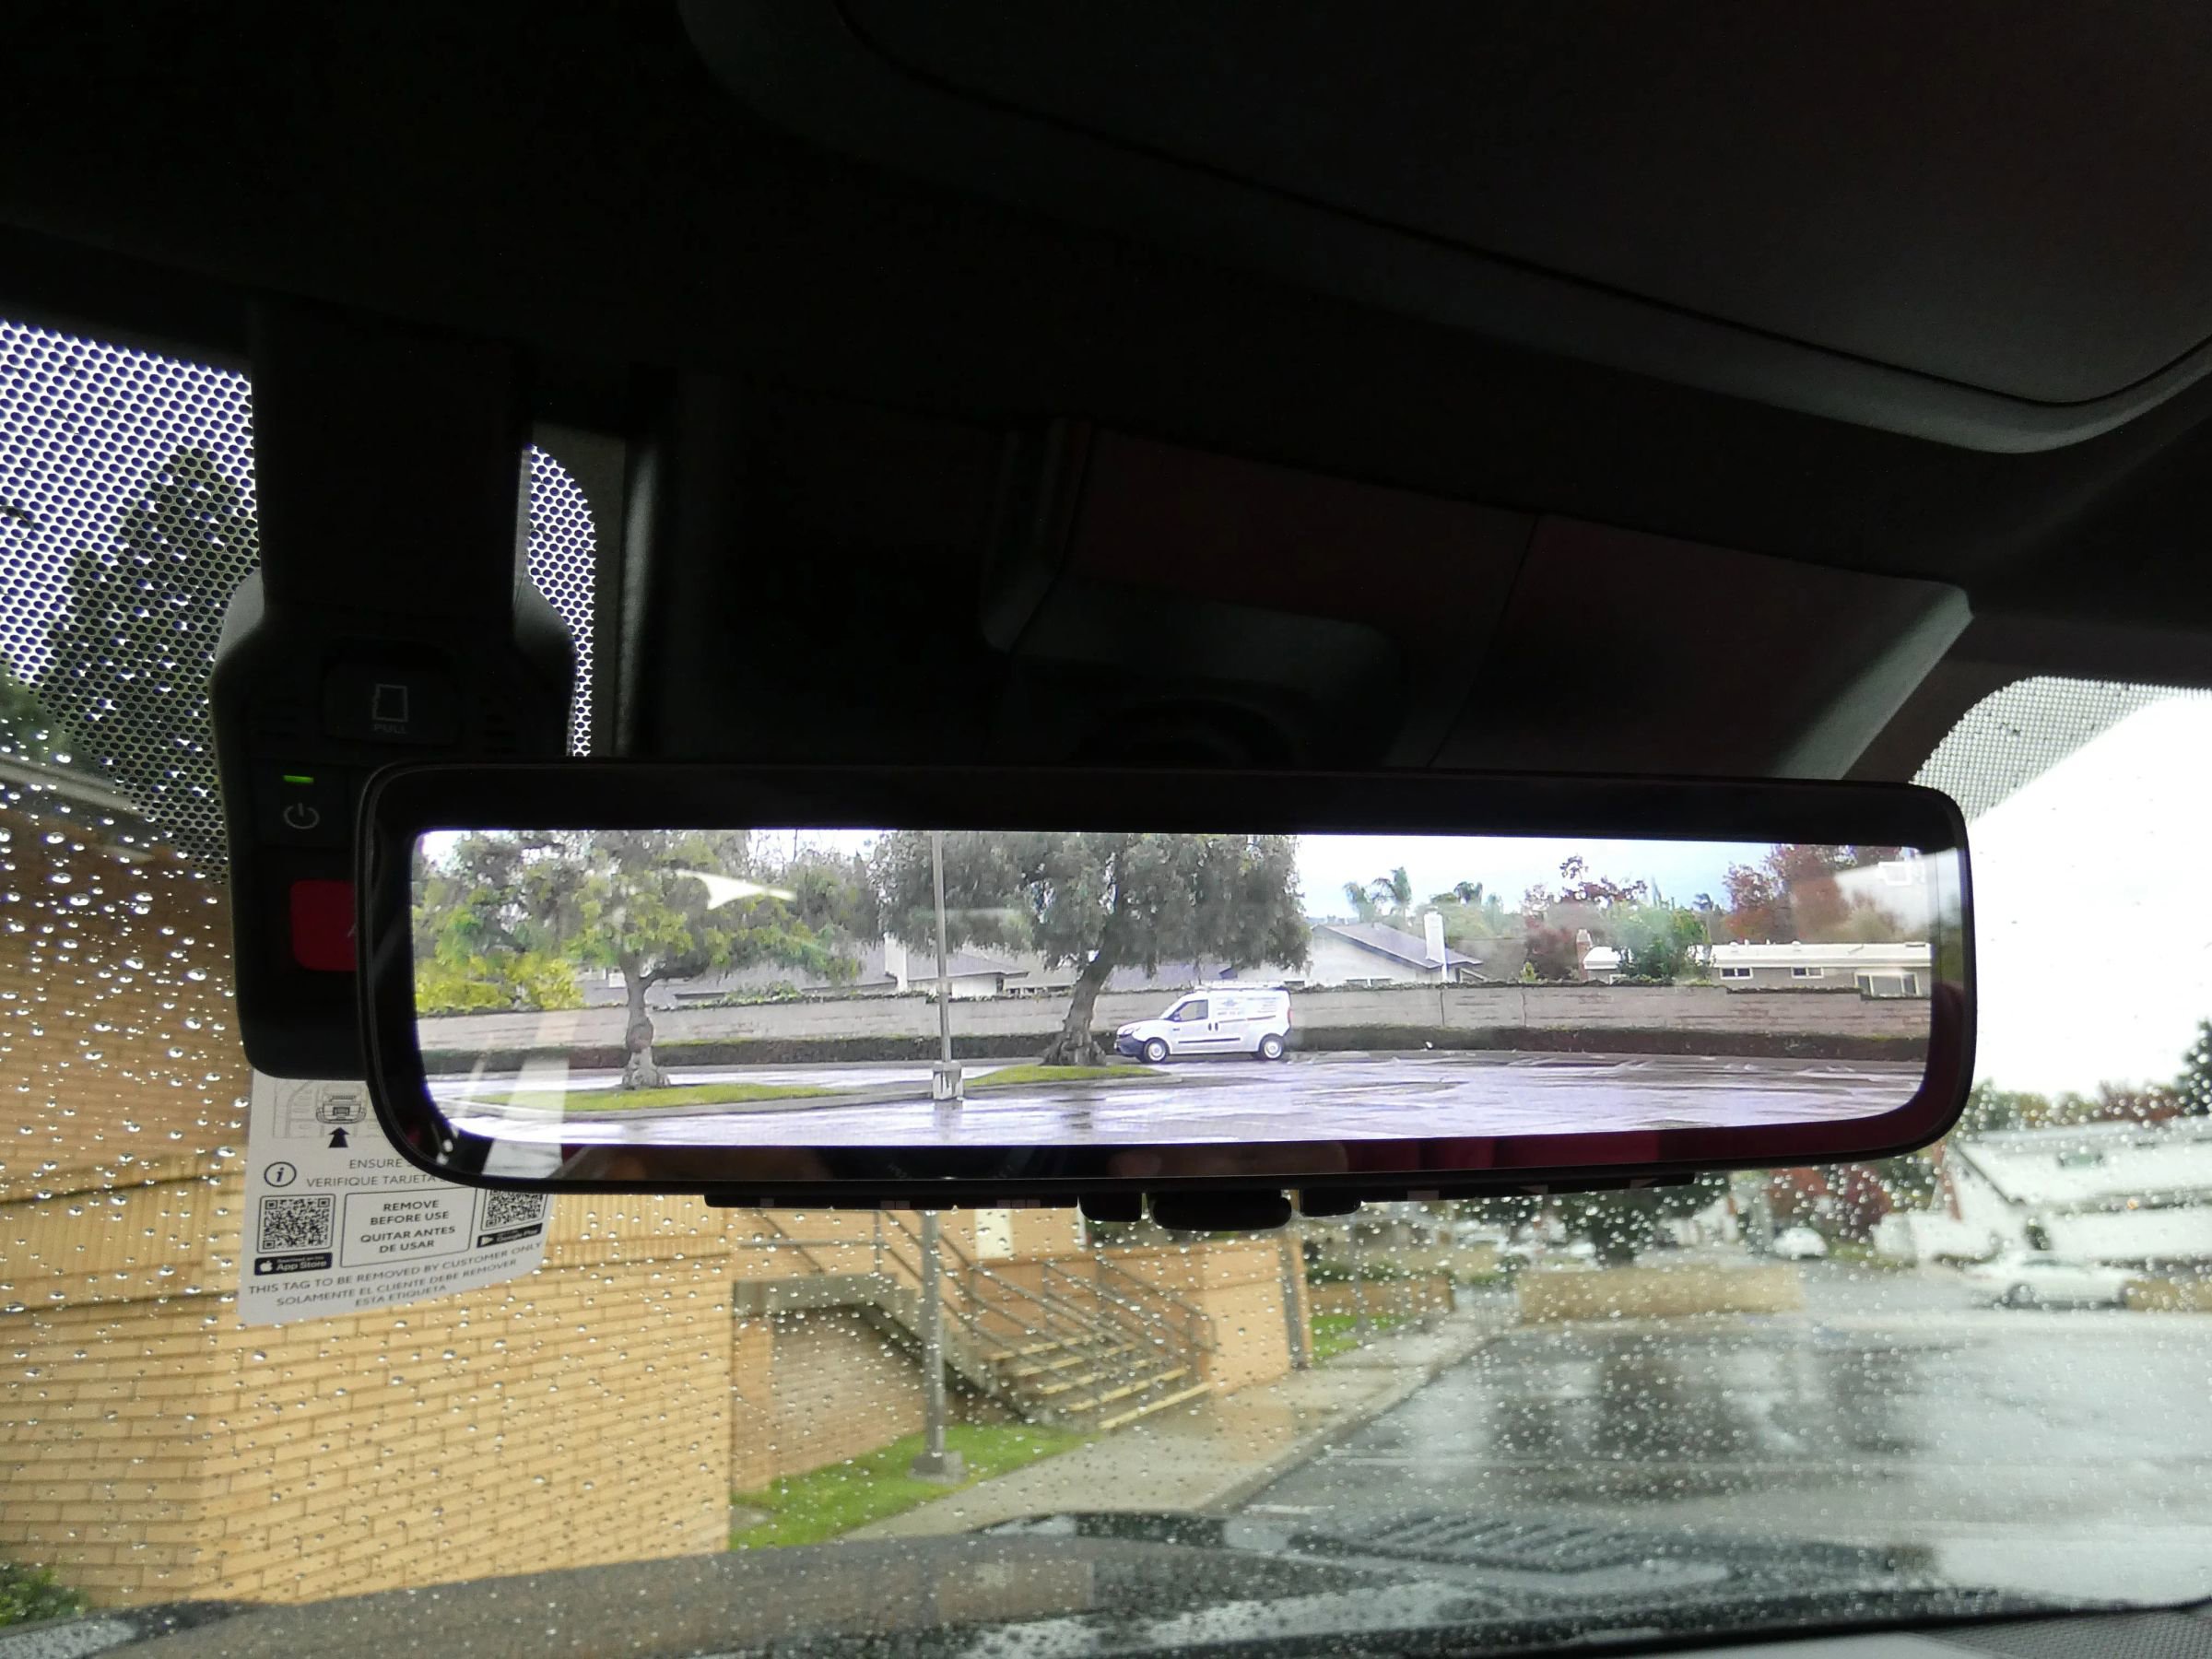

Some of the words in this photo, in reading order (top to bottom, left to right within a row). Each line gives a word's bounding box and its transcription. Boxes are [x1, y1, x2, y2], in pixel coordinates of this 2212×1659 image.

[349, 1159, 403, 1169] ENSURE
[307, 1176, 378, 1187] VERIFIQUE
[383, 1174, 436, 1184] TARJETA
[383, 1200, 440, 1212] REMOVE
[371, 1214, 421, 1226] BEFORE
[425, 1211, 450, 1221] USE
[360, 1231, 411, 1242] QUITAR
[414, 1226, 455, 1238] ANTES
[379, 1243, 396, 1253] DE
[400, 1241, 435, 1252] USAR
[249, 1283, 278, 1294] THIS
[284, 1280, 310, 1290] TAG
[315, 1277, 333, 1287] TO
[337, 1275, 352, 1285] BE
[357, 1267, 420, 1282] REMOVED
[423, 1263, 440, 1274] BY
[442, 1251, 508, 1270] CUSTOMER
[511, 1241, 542, 1254] ONLY
[276, 1263, 299, 1271] App
[276, 1289, 355, 1306] SOLAMENTE
[359, 1287, 371, 1296] EL
[377, 1278, 424, 1293] CLIENTE
[429, 1272, 458, 1284] DEBE
[463, 1259, 517, 1277] REMOVER
[355, 1296, 385, 1307] ESTA
[390, 1285, 447, 1301] ETIQUETA
